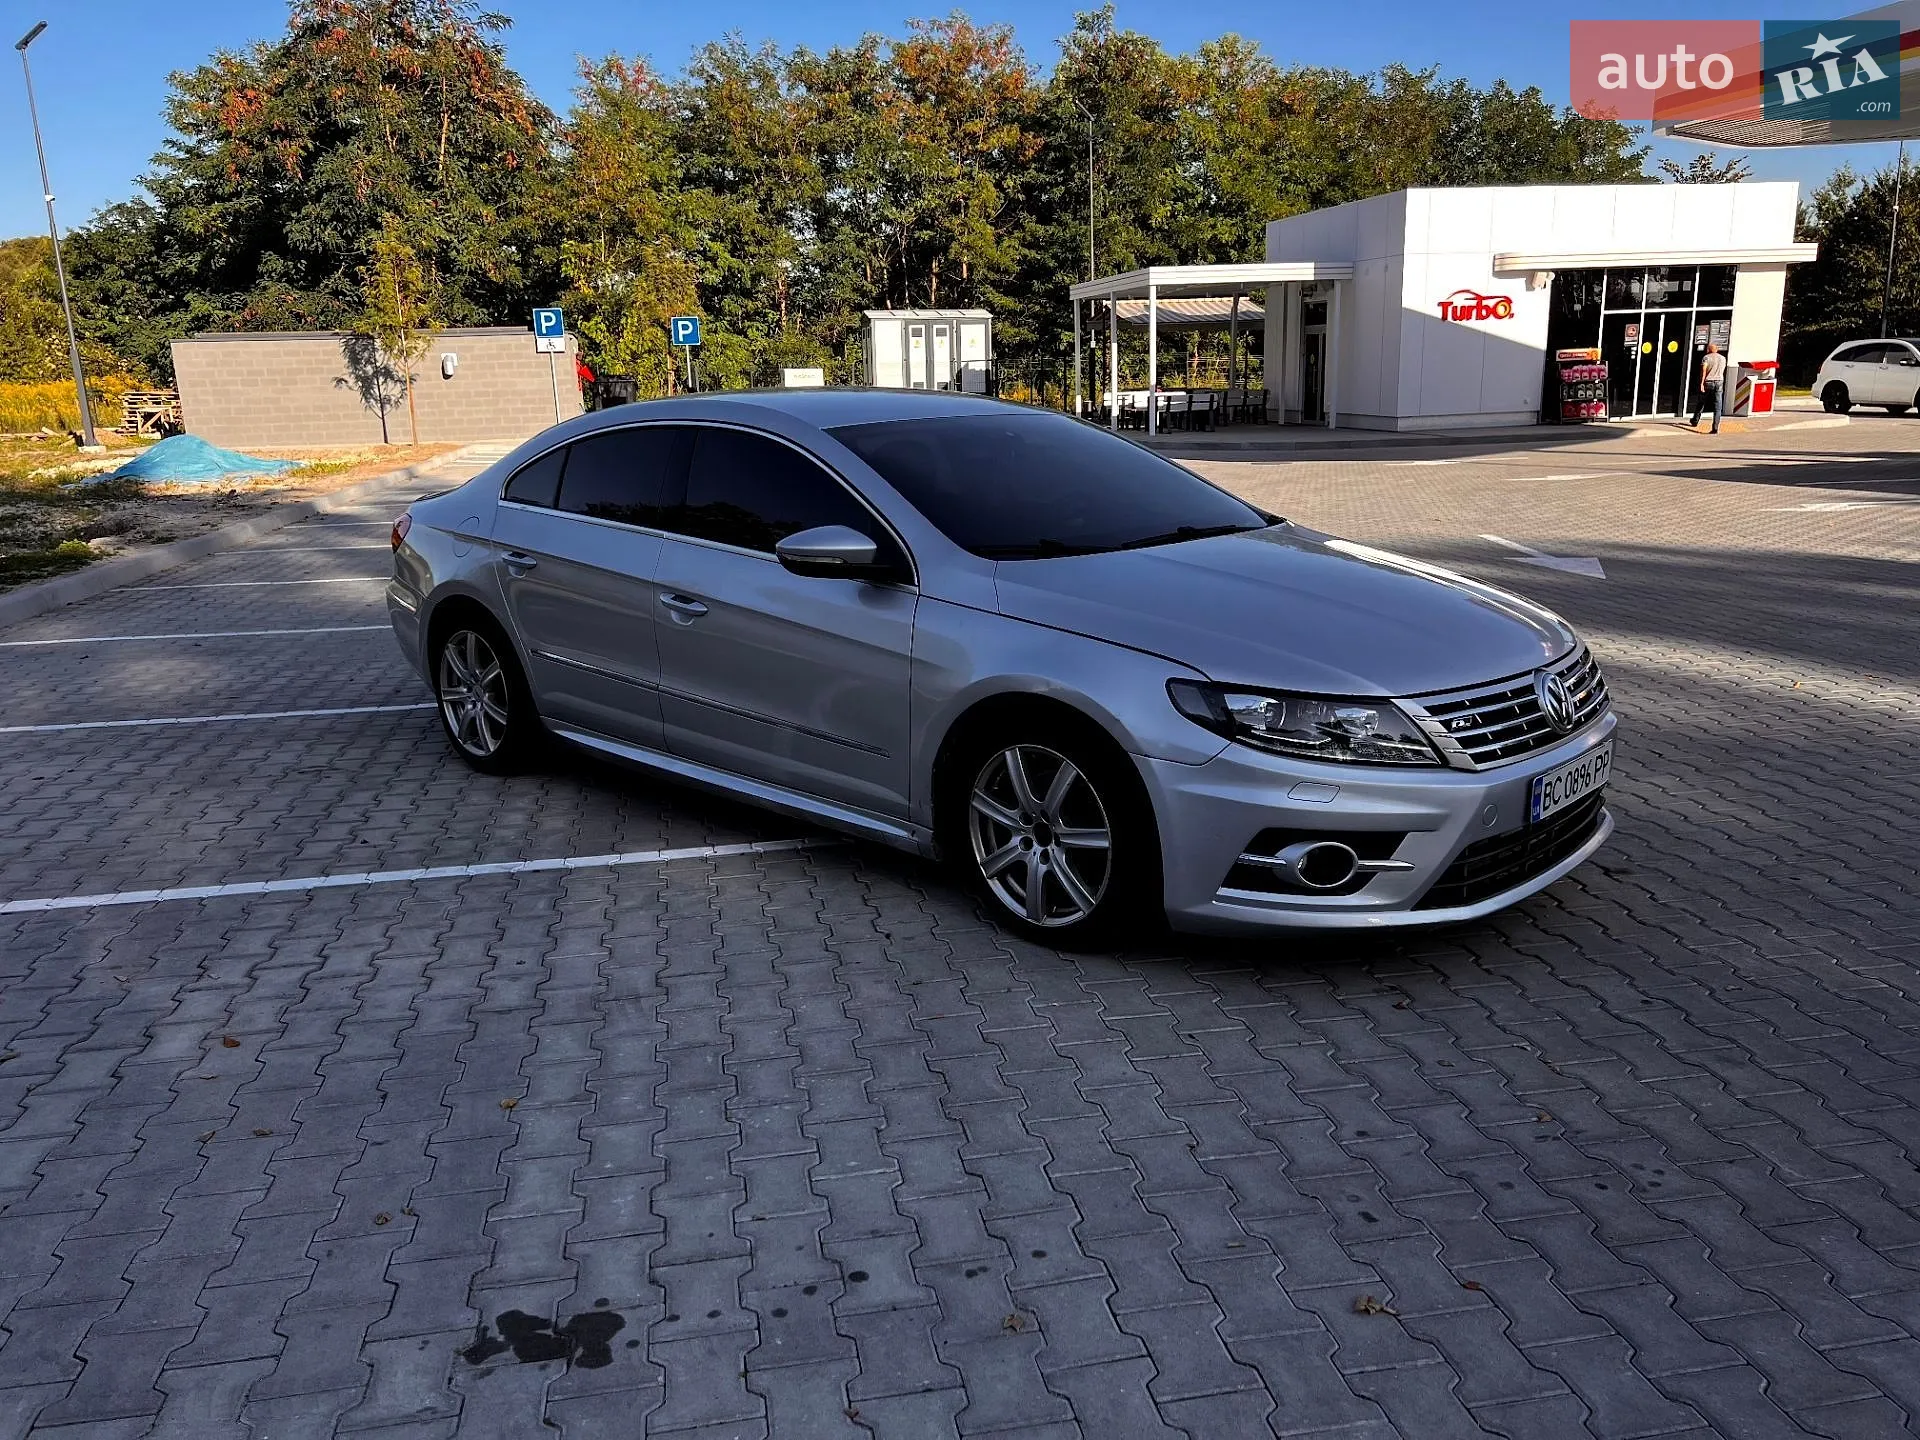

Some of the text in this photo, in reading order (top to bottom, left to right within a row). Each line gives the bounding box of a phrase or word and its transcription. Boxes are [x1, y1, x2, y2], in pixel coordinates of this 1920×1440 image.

[540, 311, 557, 334] P
[677, 320, 693, 342] P
[1543, 750, 1609, 811] BC 0896 PP
